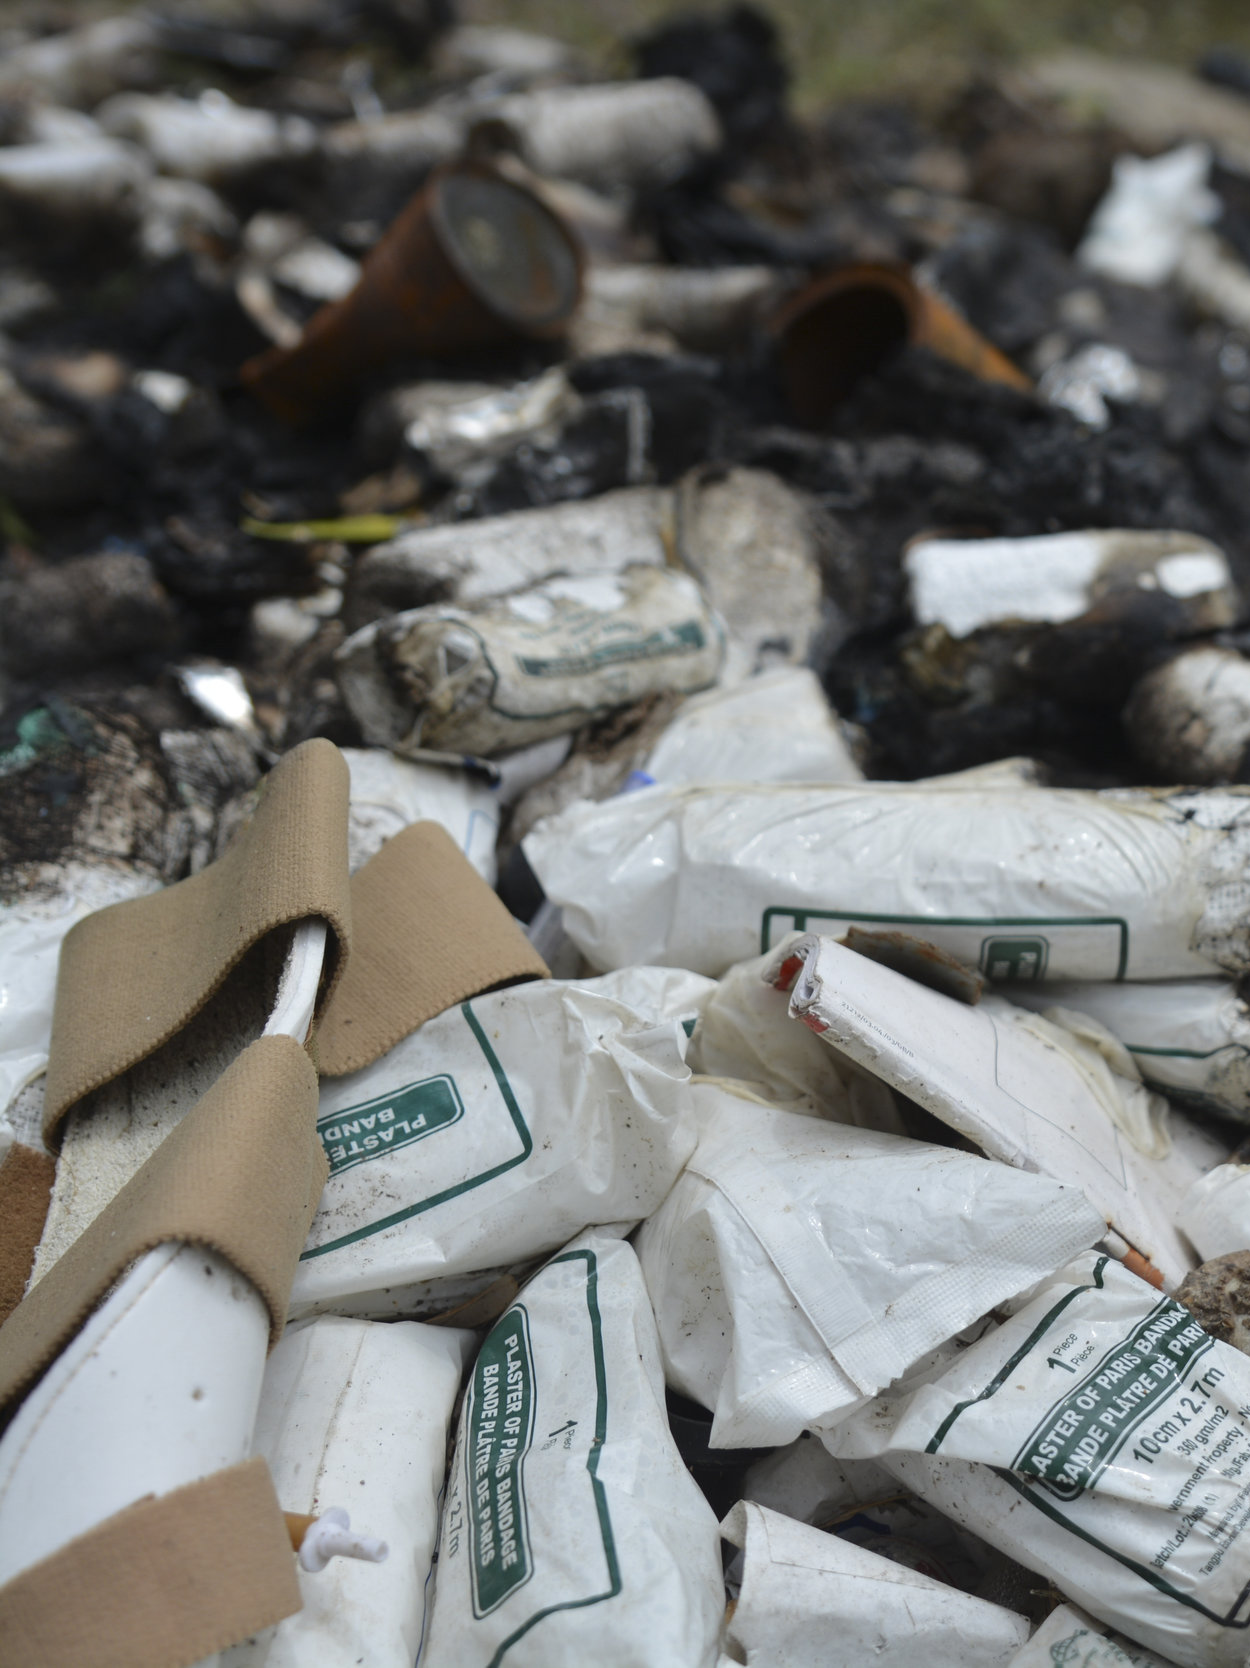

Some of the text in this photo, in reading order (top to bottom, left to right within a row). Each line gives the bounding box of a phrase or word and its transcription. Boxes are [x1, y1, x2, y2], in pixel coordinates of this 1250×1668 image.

[323, 1113, 427, 1165] PLASTE
[1025, 1302, 1189, 1477] ASTER OF PARIS BANDA
[1048, 1331, 1078, 1374] 1 Piece
[1100, 1373, 1157, 1427] PLÂTRE
[1149, 1353, 1177, 1377] DE
[1133, 1365, 1225, 1464] 10cm x 2.7m
[475, 1364, 500, 1567] BANDE PLÂTRE DE PARIS
[495, 1334, 520, 1570] PLASTER OF PARIS BANDAGE
[1176, 1404, 1228, 1456] 360 gm/m2
[1169, 1461, 1209, 1510] vernment
[1202, 1427, 1243, 1463] Property
[448, 1502, 462, 1557] 2.7m
[1199, 1547, 1223, 1576] Tangpu
